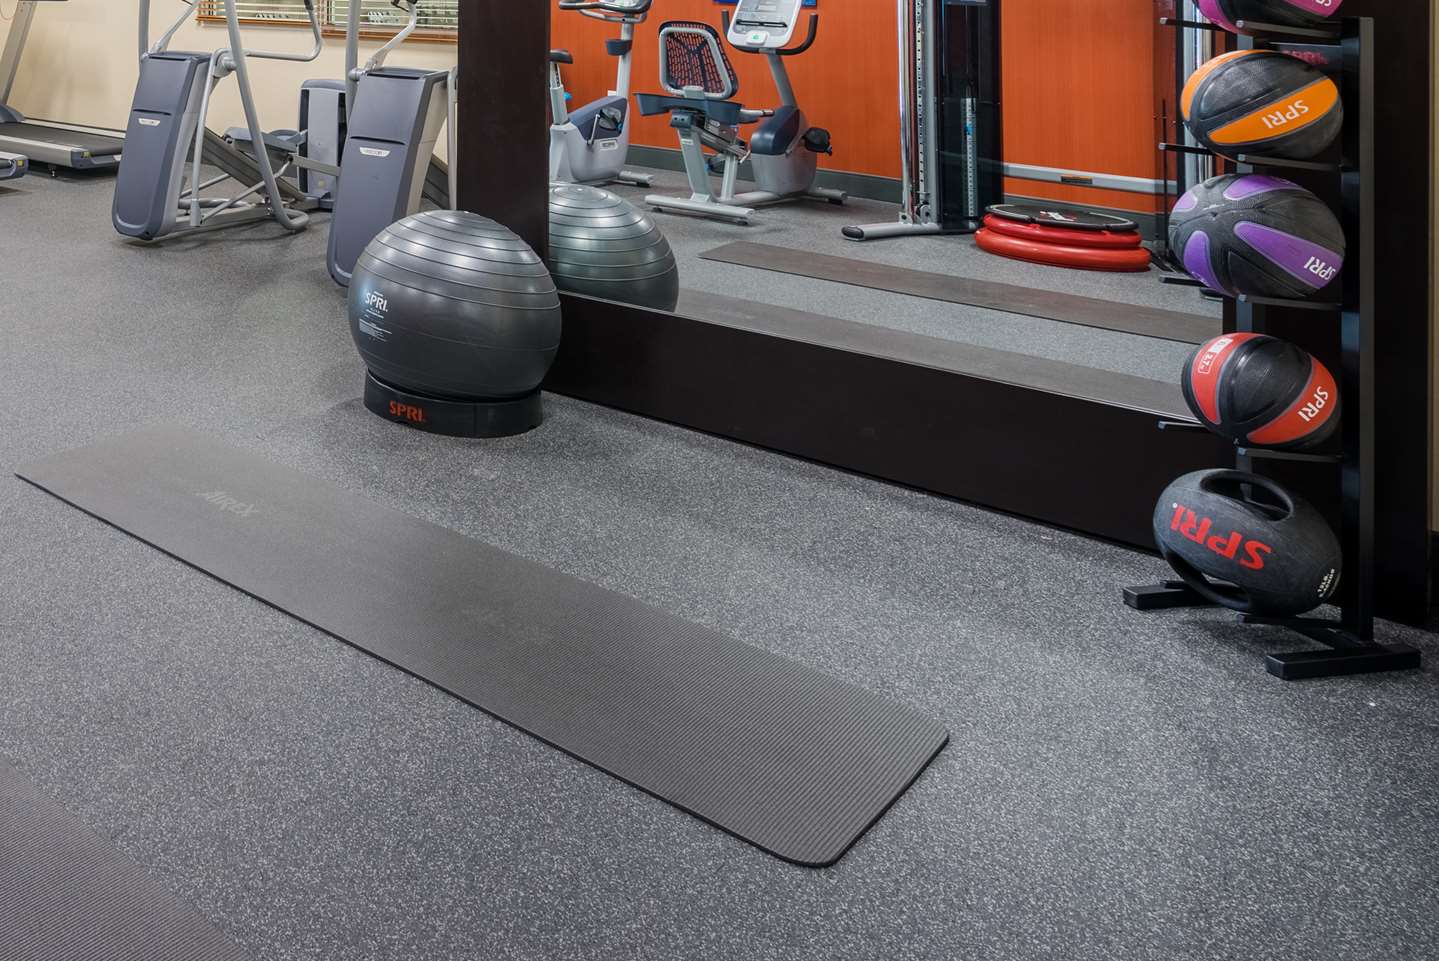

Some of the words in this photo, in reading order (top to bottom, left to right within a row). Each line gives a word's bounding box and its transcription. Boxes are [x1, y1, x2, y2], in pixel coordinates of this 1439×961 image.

[1262, 100, 1309, 129] SPRI
[1303, 256, 1336, 280] SPRI
[389, 400, 424, 422] SPRI
[1297, 386, 1329, 422] SPRI
[1170, 505, 1272, 570] SPRI
